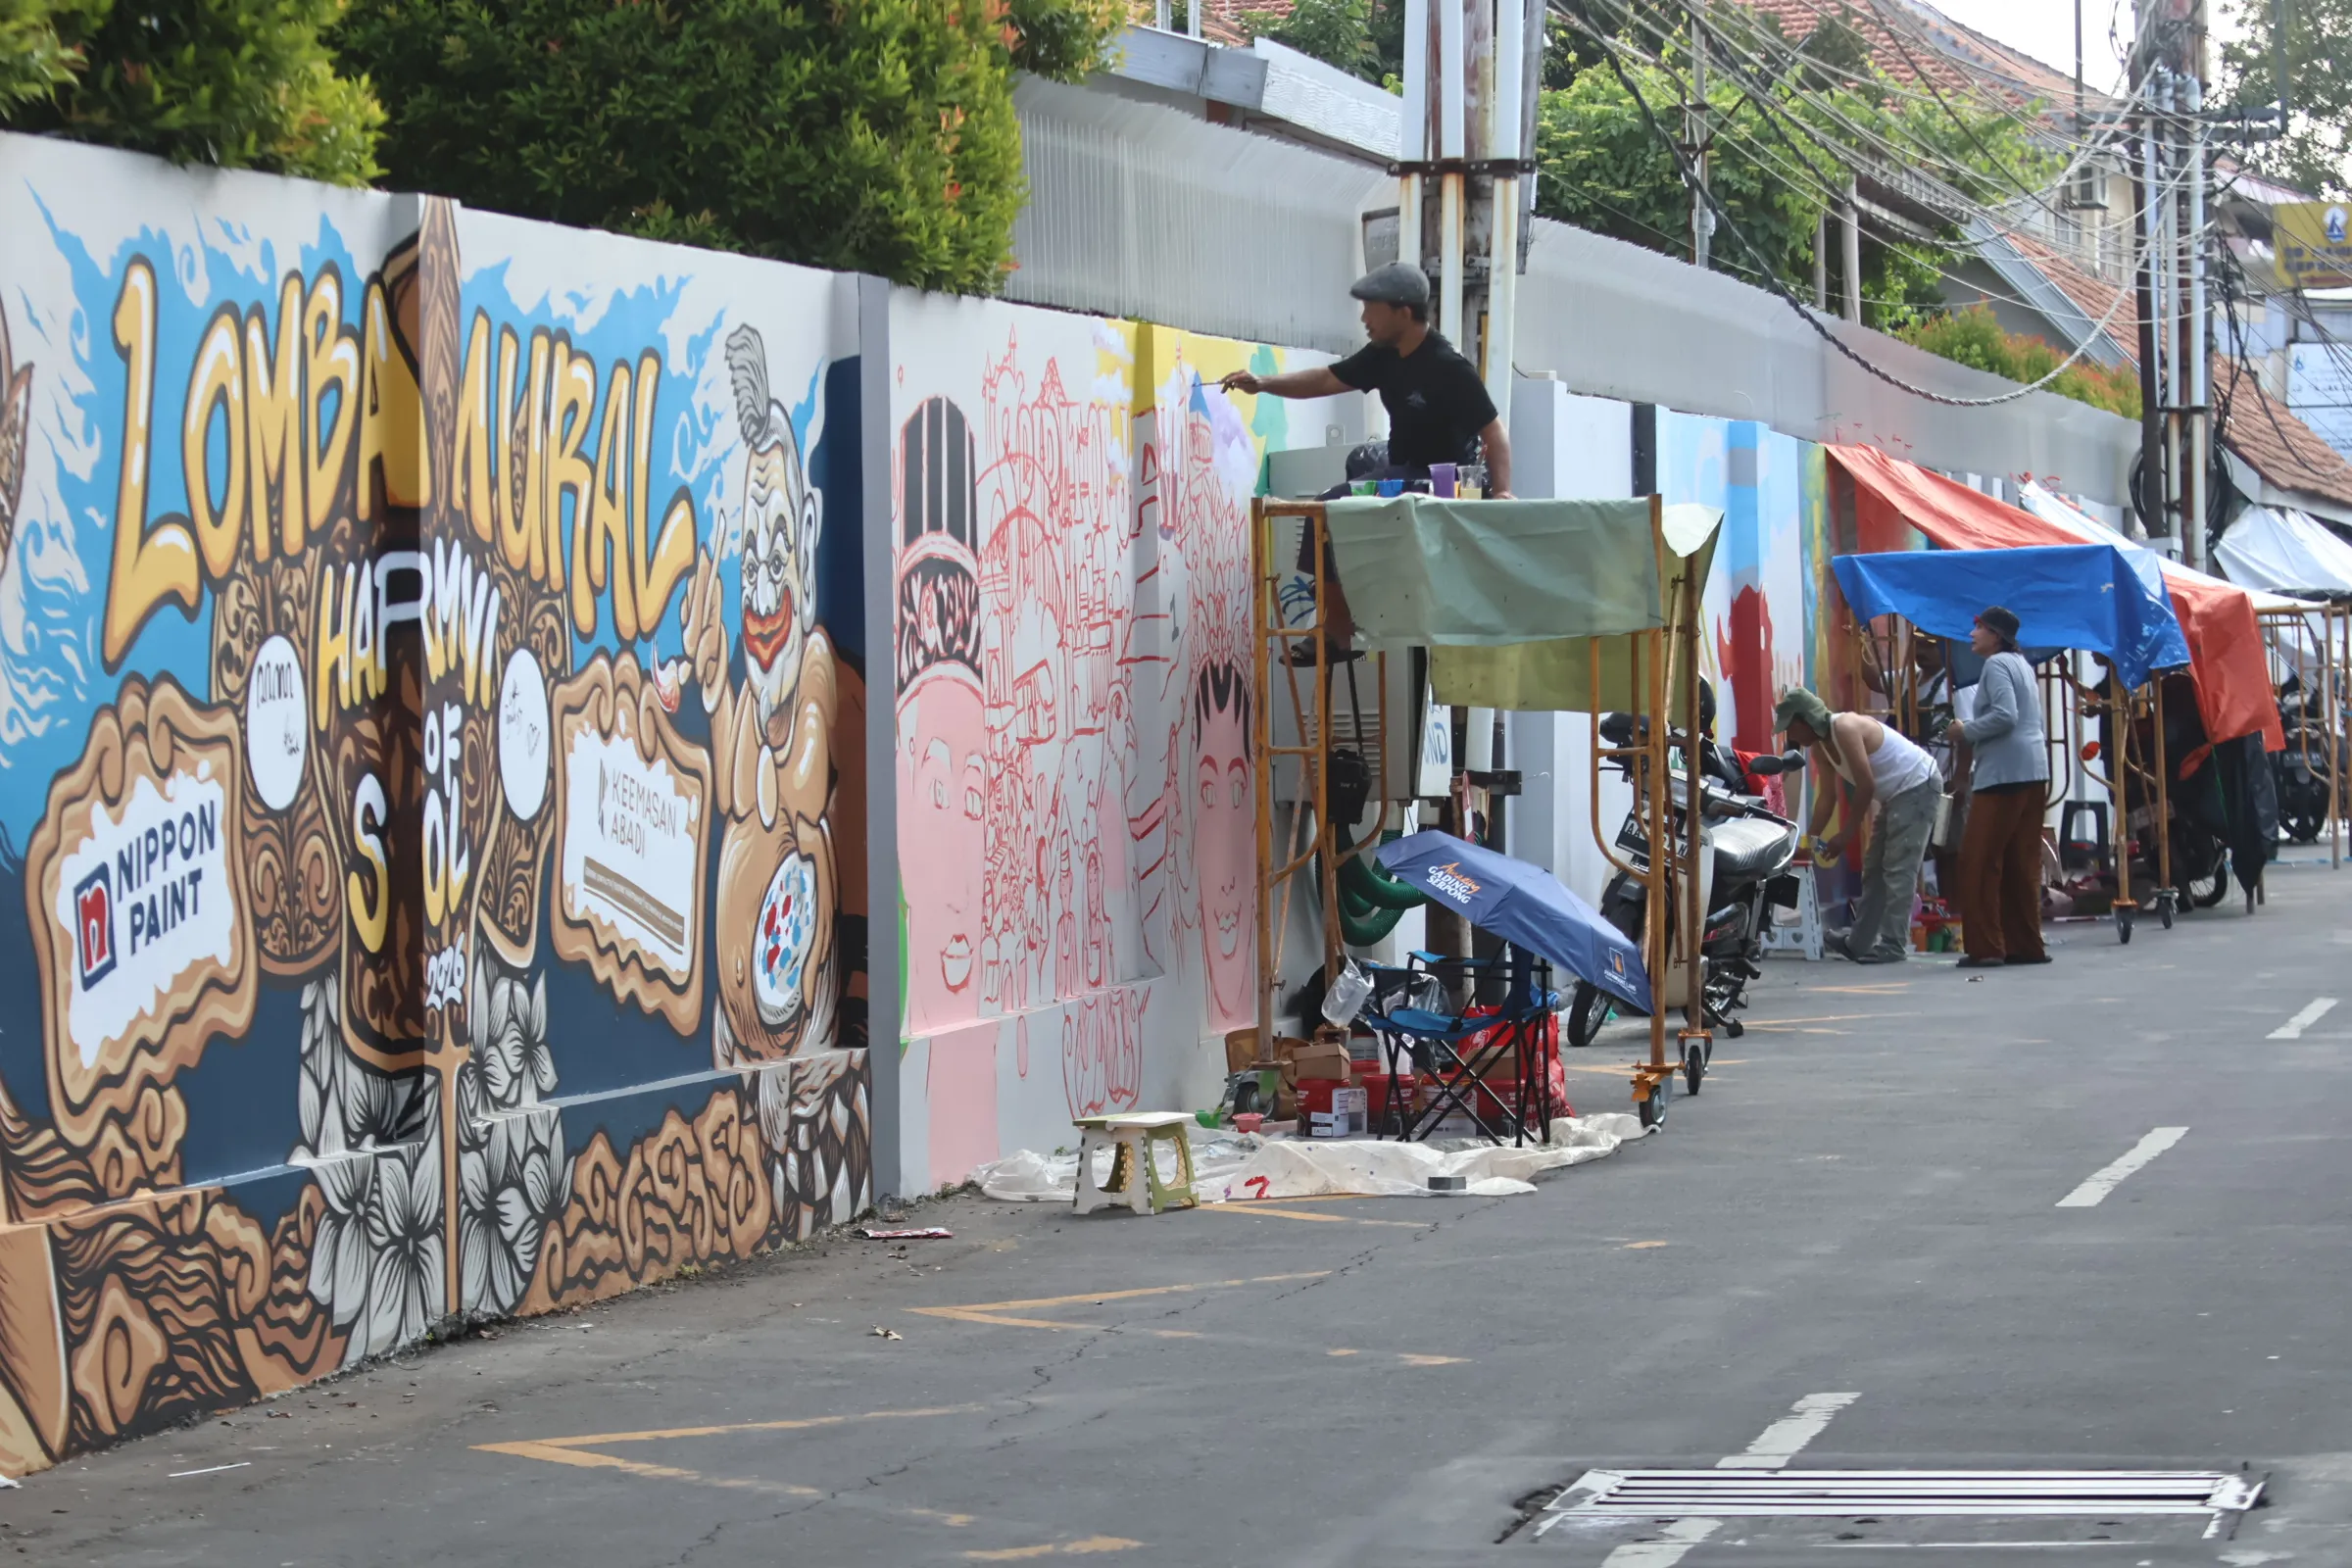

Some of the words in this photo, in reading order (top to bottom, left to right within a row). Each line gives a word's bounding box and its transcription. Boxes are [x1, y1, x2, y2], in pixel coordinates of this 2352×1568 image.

[104, 255, 432, 670] LOMBA
[452, 306, 697, 641] MURAL
[424, 701, 462, 799] OF
[611, 811, 646, 859] ABADI
[612, 767, 676, 840] KEEMASAN
[117, 800, 215, 904] NIPPON
[1426, 875, 1471, 904] SERPONG
[1428, 866, 1470, 893] GADING
[129, 867, 203, 956] PAINT
[425, 932, 466, 1010] 2026
